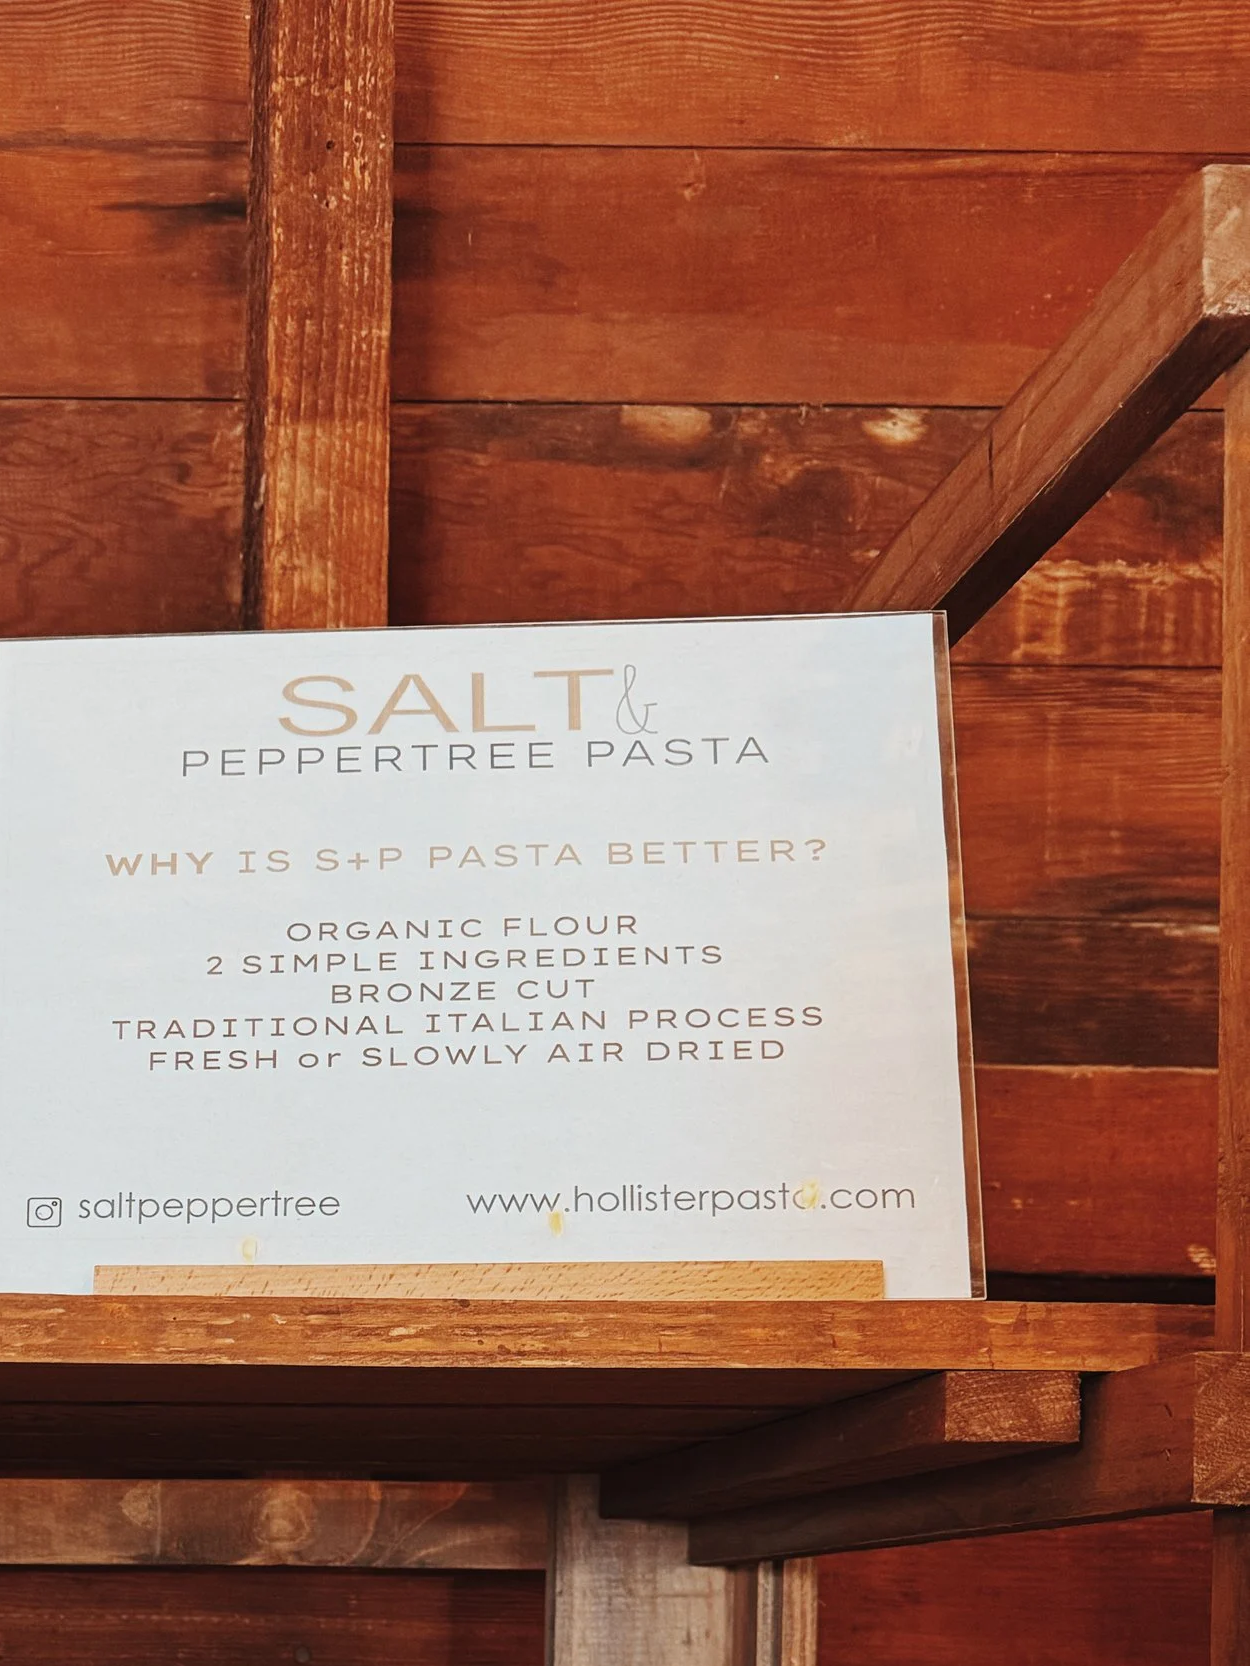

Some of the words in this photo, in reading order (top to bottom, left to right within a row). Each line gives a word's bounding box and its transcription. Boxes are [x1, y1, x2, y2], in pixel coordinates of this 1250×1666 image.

[277, 667, 612, 737] SALT
[615, 663, 658, 736] &
[183, 738, 553, 776] PEPPERTREE
[588, 730, 768, 767] PASTA
[105, 852, 213, 876] WHY
[239, 850, 289, 873] IS
[316, 848, 402, 871] S+P
[430, 844, 582, 868] PASTA
[608, 839, 826, 864] BETTER?
[287, 919, 481, 941] ORGANIC
[504, 916, 636, 936] FLOUR
[207, 956, 222, 975] 2
[243, 952, 396, 974] SIMPLE
[420, 946, 721, 970] INGREDIENTS
[332, 982, 495, 1003] BRONZE
[518, 979, 594, 999] CUT
[112, 1015, 403, 1039] TRADITIONAL
[426, 1011, 605, 1033] ITALIAN
[630, 1007, 822, 1029] PROCESS
[150, 1050, 276, 1070] FRESH
[299, 1053, 341, 1068] or
[362, 1045, 526, 1066] SLOWLY
[548, 1043, 623, 1063] AIR
[648, 1040, 784, 1061] DRIED
[79, 1190, 340, 1224] saltpeppertree
